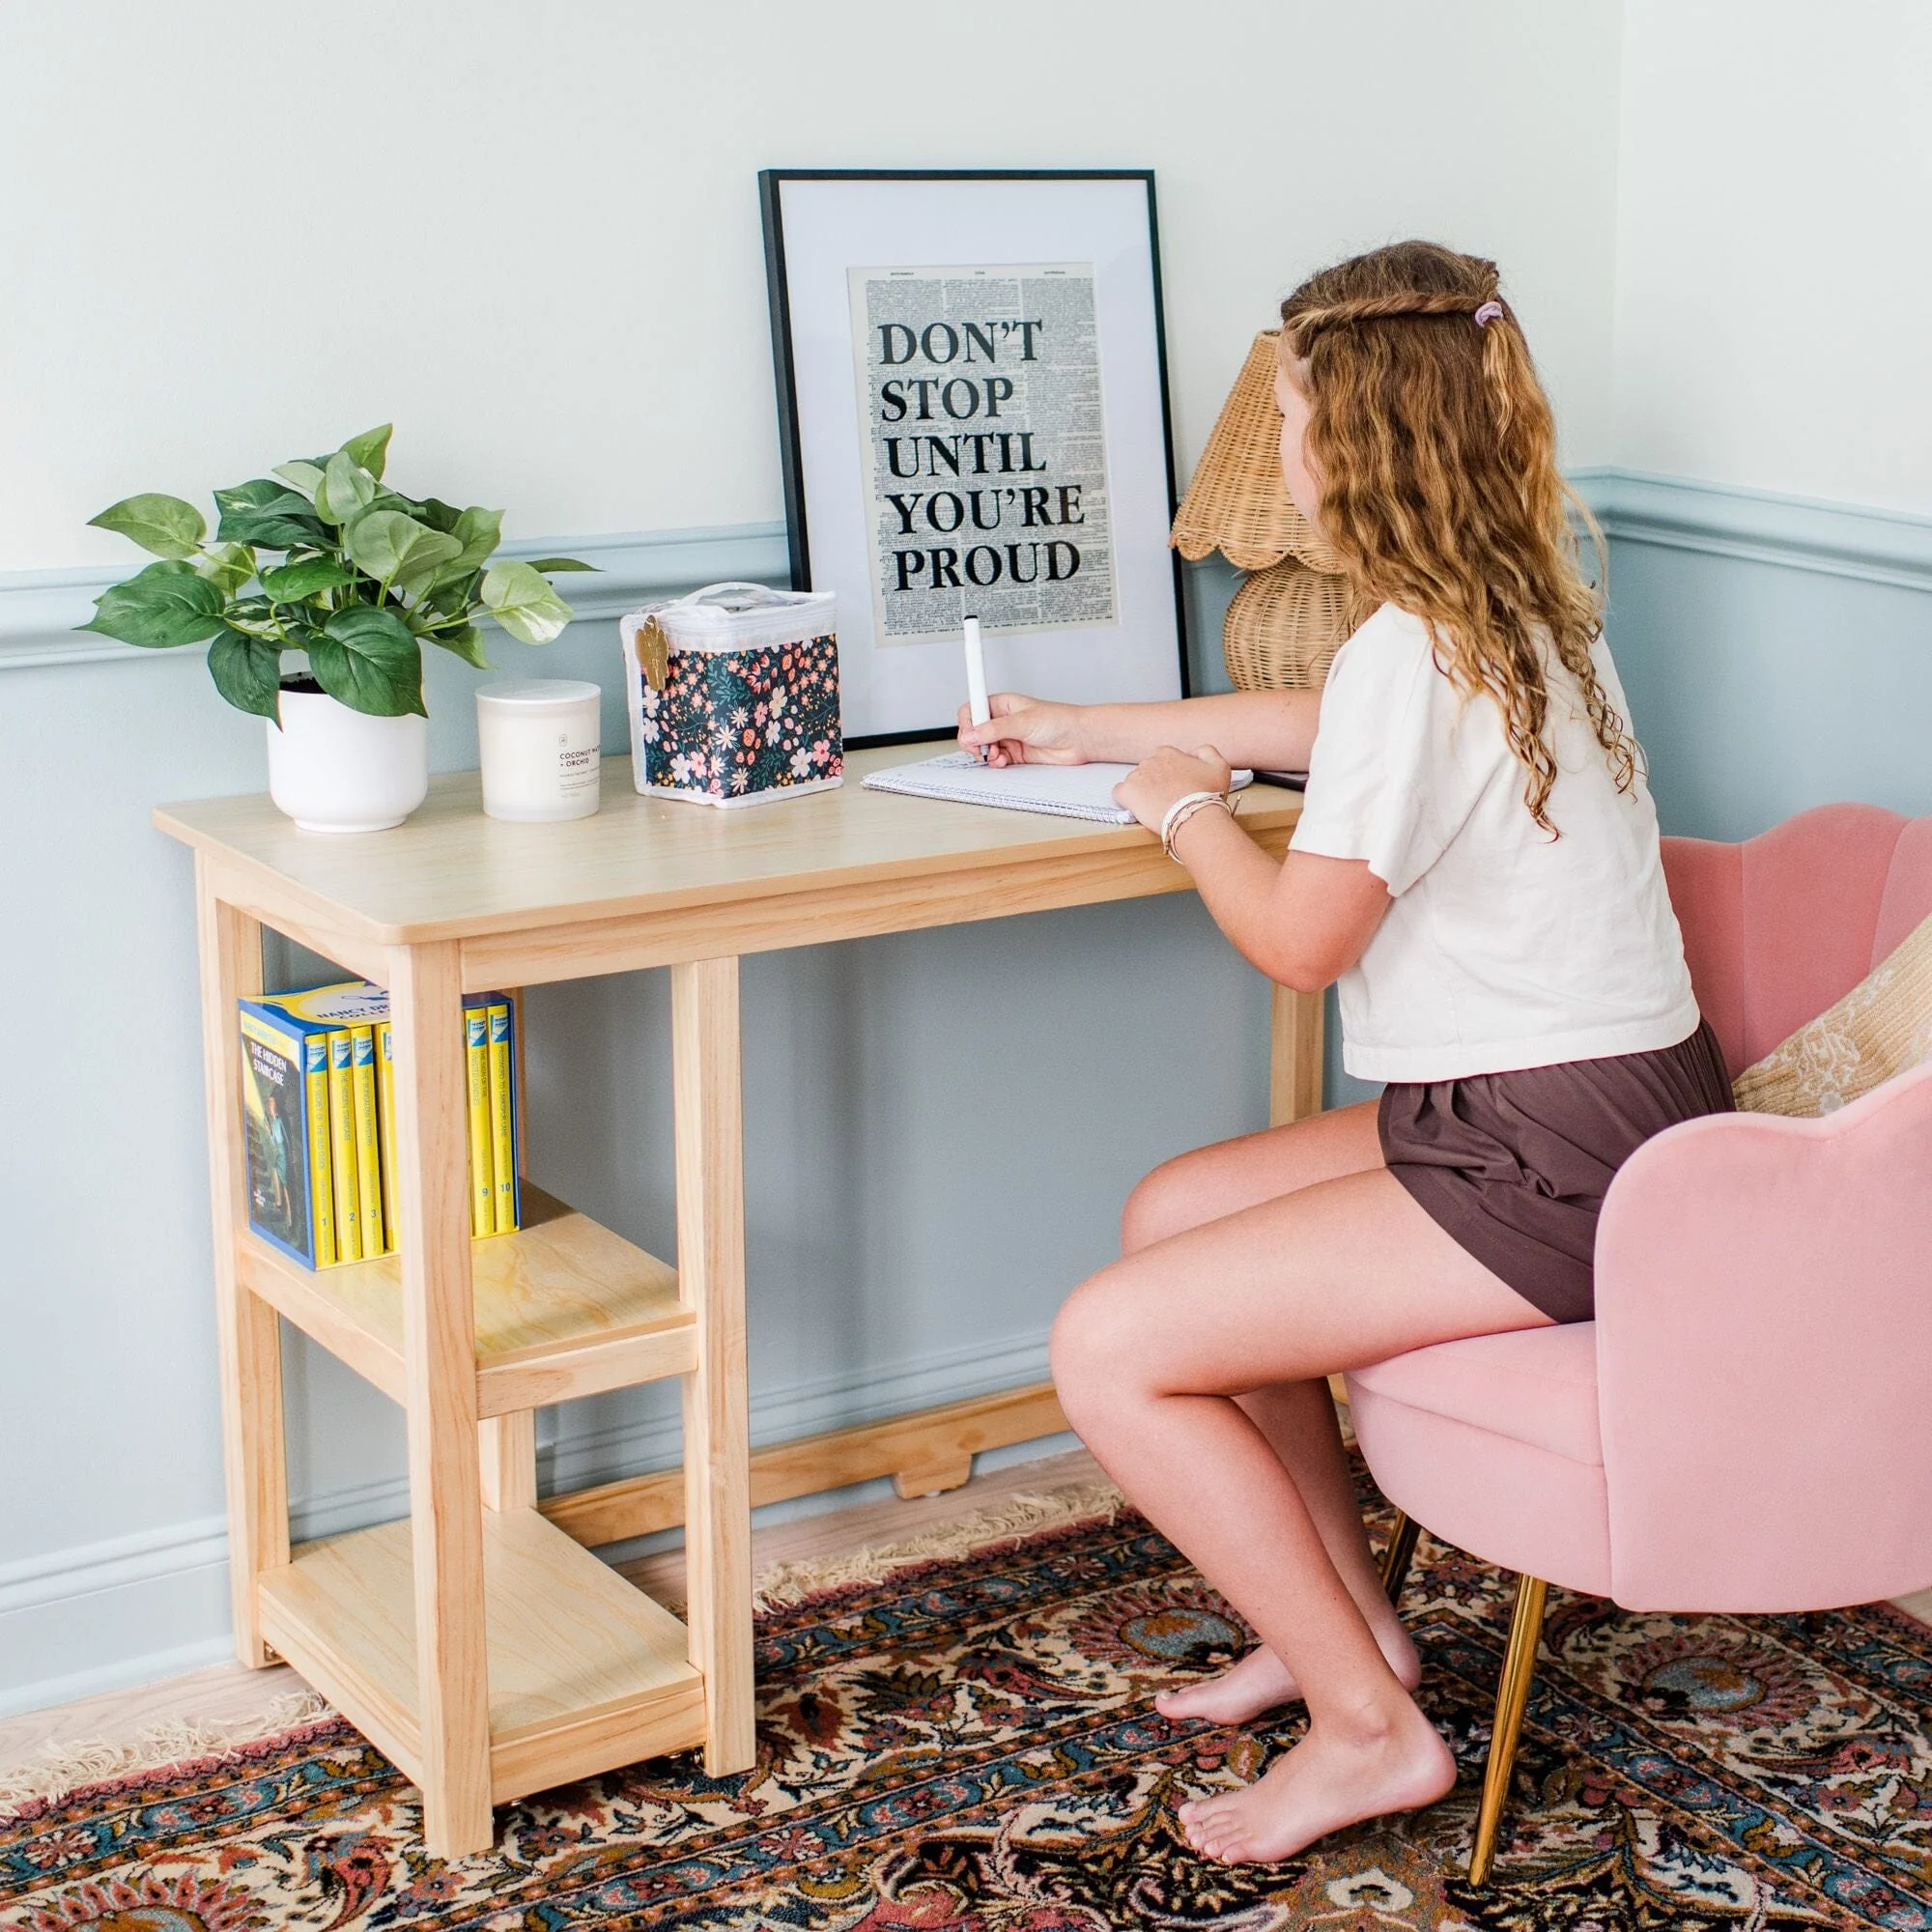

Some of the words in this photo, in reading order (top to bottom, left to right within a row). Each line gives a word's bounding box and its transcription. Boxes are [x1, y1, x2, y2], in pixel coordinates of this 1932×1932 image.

[878, 319, 1042, 365] DON’T
[881, 377, 1013, 422] STOP
[883, 432, 1047, 478] UNTIL
[885, 484, 1085, 534] YOU’RE
[893, 540, 1081, 592] PROUD
[560, 749, 590, 759] COCONUT
[565, 757, 589, 767] ORCHID
[317, 1008, 365, 1018] NANCY
[251, 1041, 263, 1058] THE
[263, 1048, 287, 1072] HIDDEN
[253, 1058, 285, 1087] STAIRCASE
[482, 1187, 488, 1197] 9
[501, 1182, 511, 1192] 10
[350, 1212, 355, 1222] 2
[371, 1209, 377, 1218] 3
[322, 1217, 327, 1227] 1
